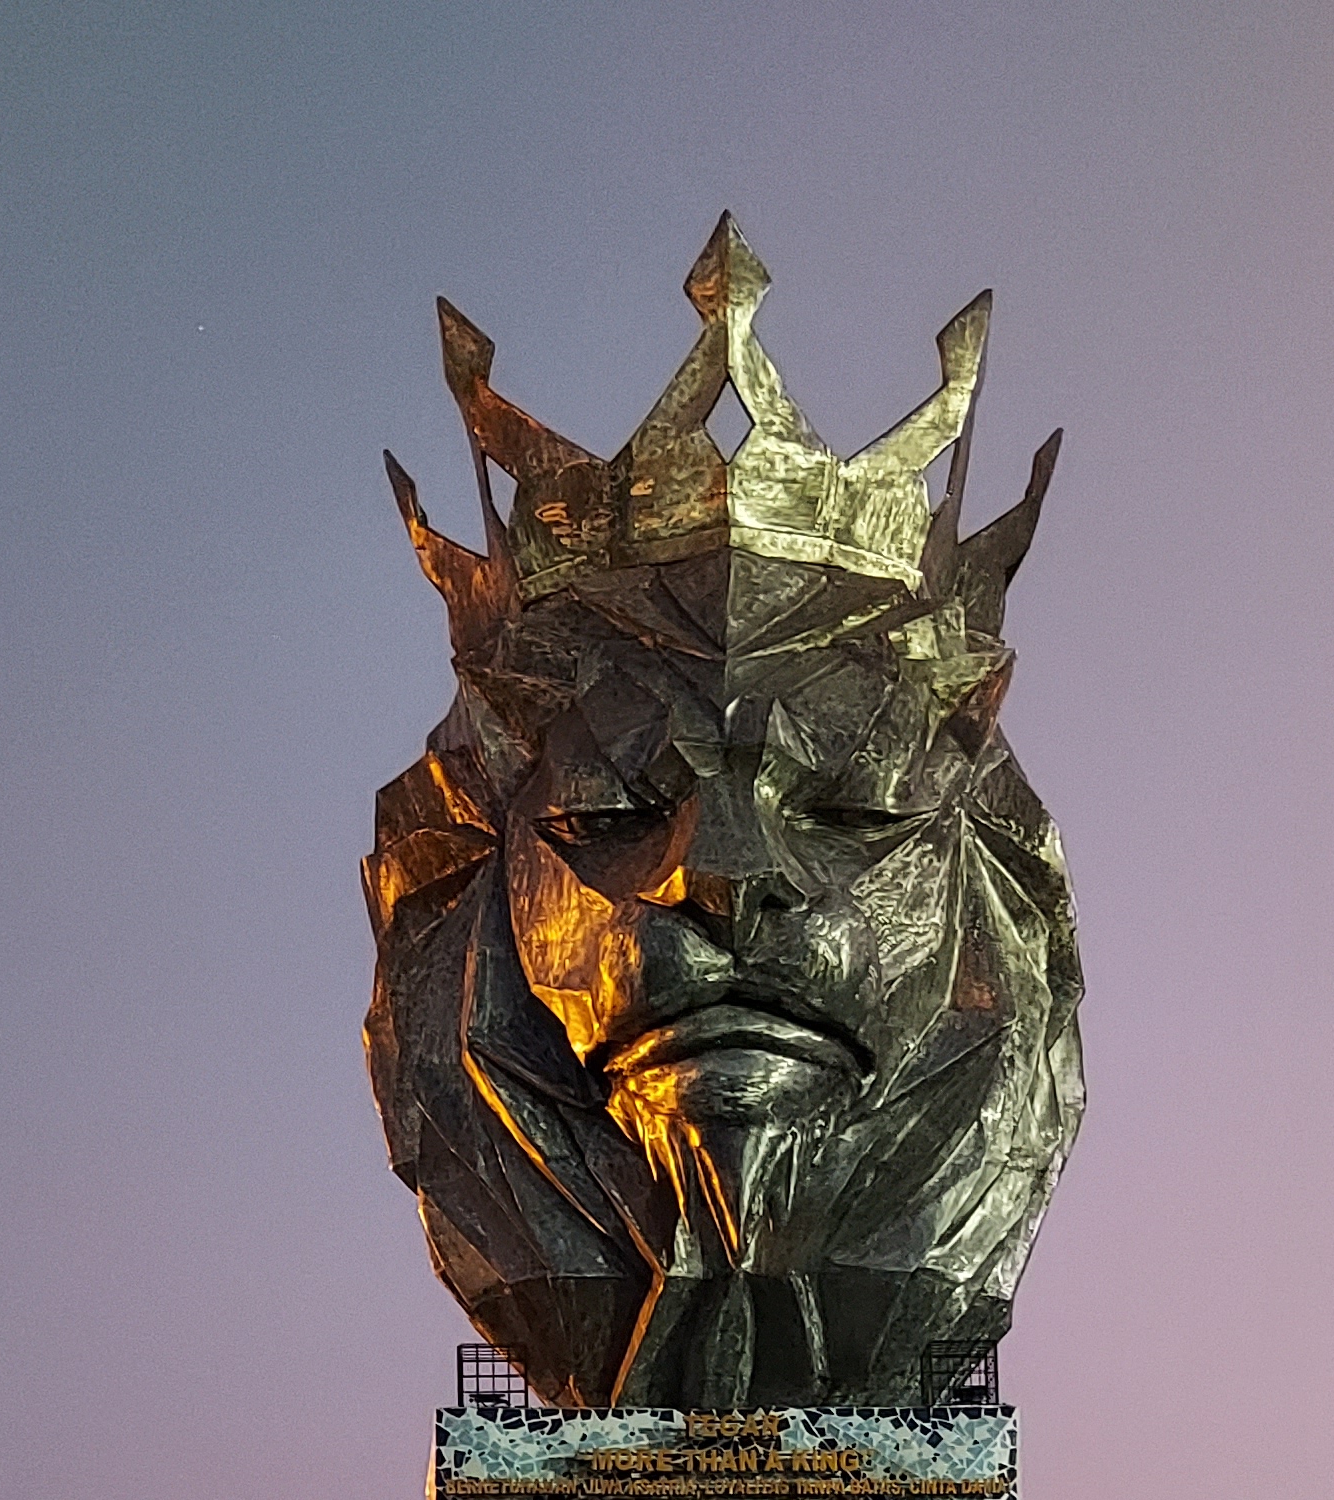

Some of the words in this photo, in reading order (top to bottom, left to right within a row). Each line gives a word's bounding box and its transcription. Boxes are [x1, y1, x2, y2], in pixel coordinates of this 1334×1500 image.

[685, 1414, 779, 1437] TEGAR
[681, 1450, 757, 1472] THAN
[764, 1450, 784, 1472] A
